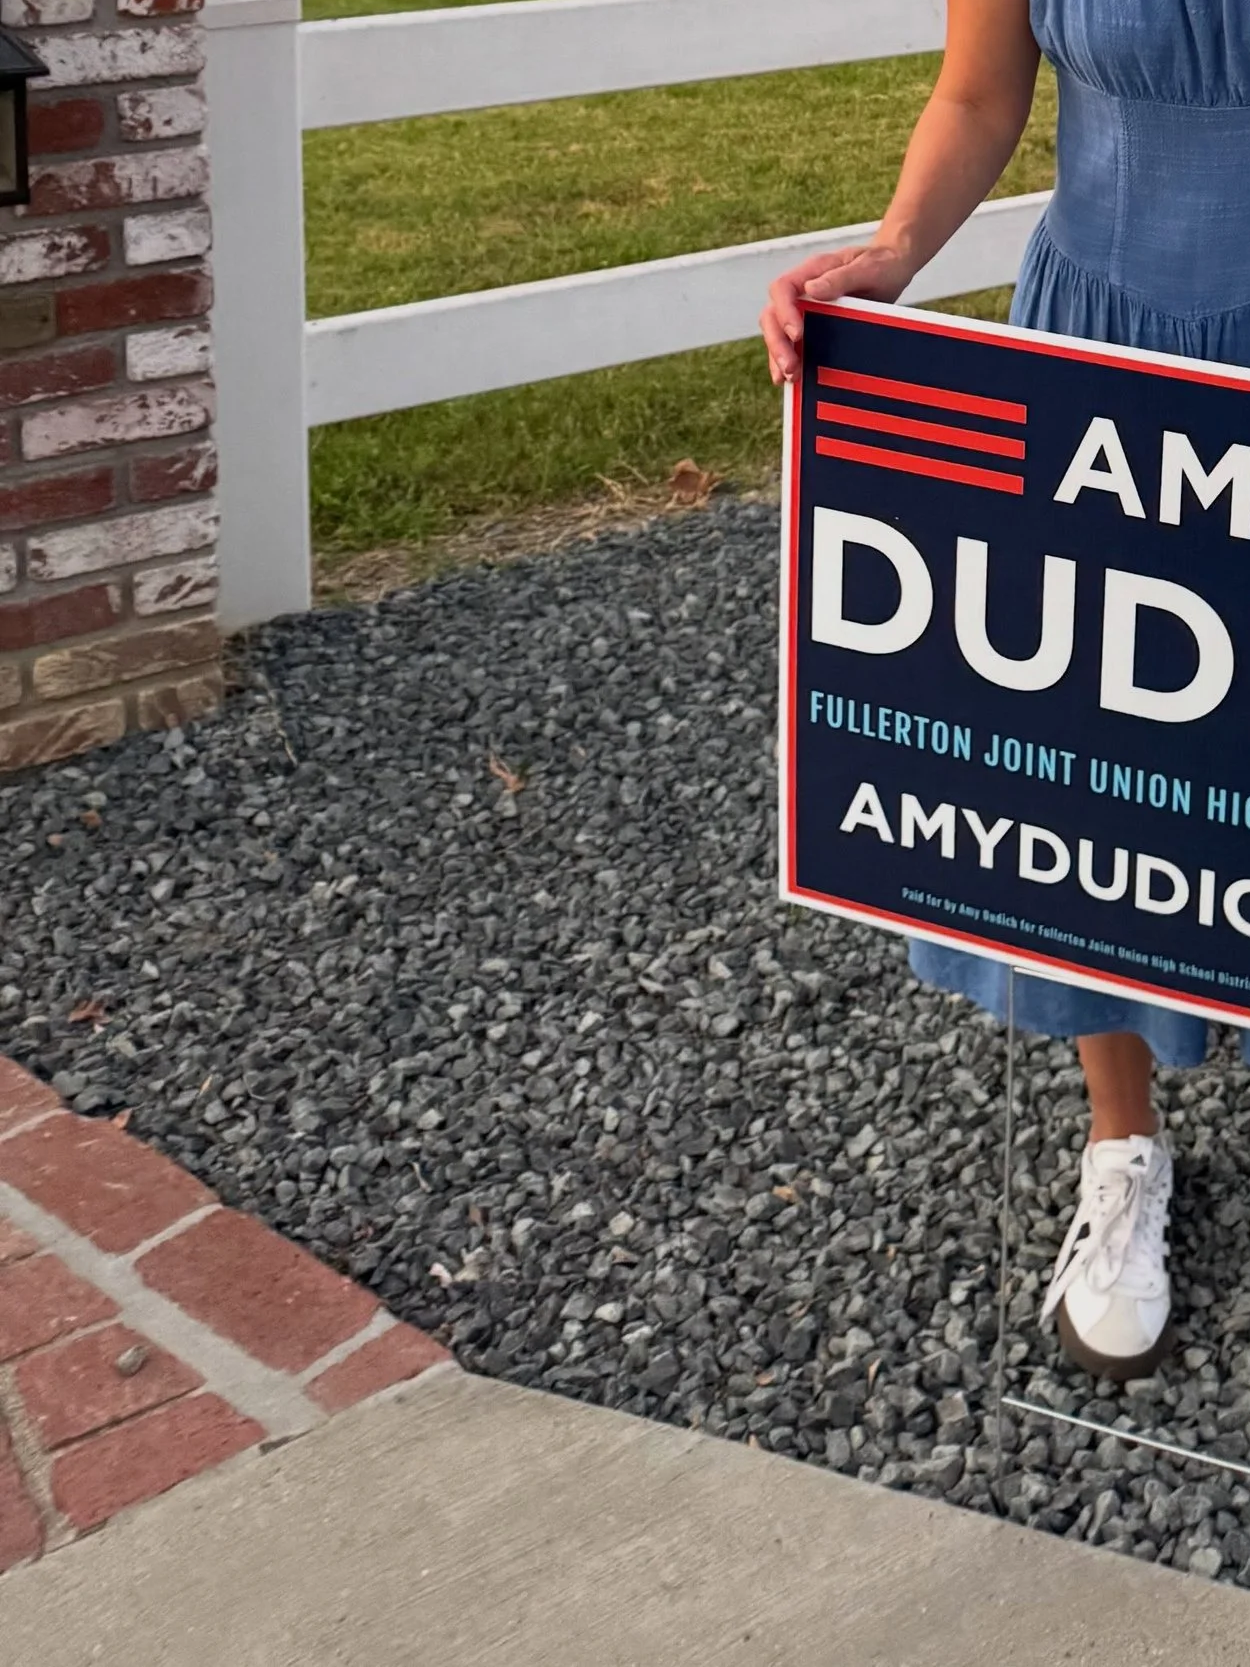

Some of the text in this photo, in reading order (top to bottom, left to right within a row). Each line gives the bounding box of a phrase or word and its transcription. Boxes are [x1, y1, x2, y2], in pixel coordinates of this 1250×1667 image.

[810, 690, 971, 761] FULLERTON
[983, 734, 1077, 786] JOINT
[1090, 758, 1191, 815] UNION
[901, 887, 925, 904] Paid
[926, 893, 943, 909] for
[944, 898, 957, 914] by
[958, 903, 981, 920] Amy
[982, 909, 1018, 929] Dudich
[1020, 918, 1036, 935] for
[1038, 924, 1086, 949] Fullerton
[1088, 938, 1116, 957] Joint
[1118, 946, 1149, 966] Union
[1151, 955, 1176, 973] High
[1178, 962, 1215, 982] School
